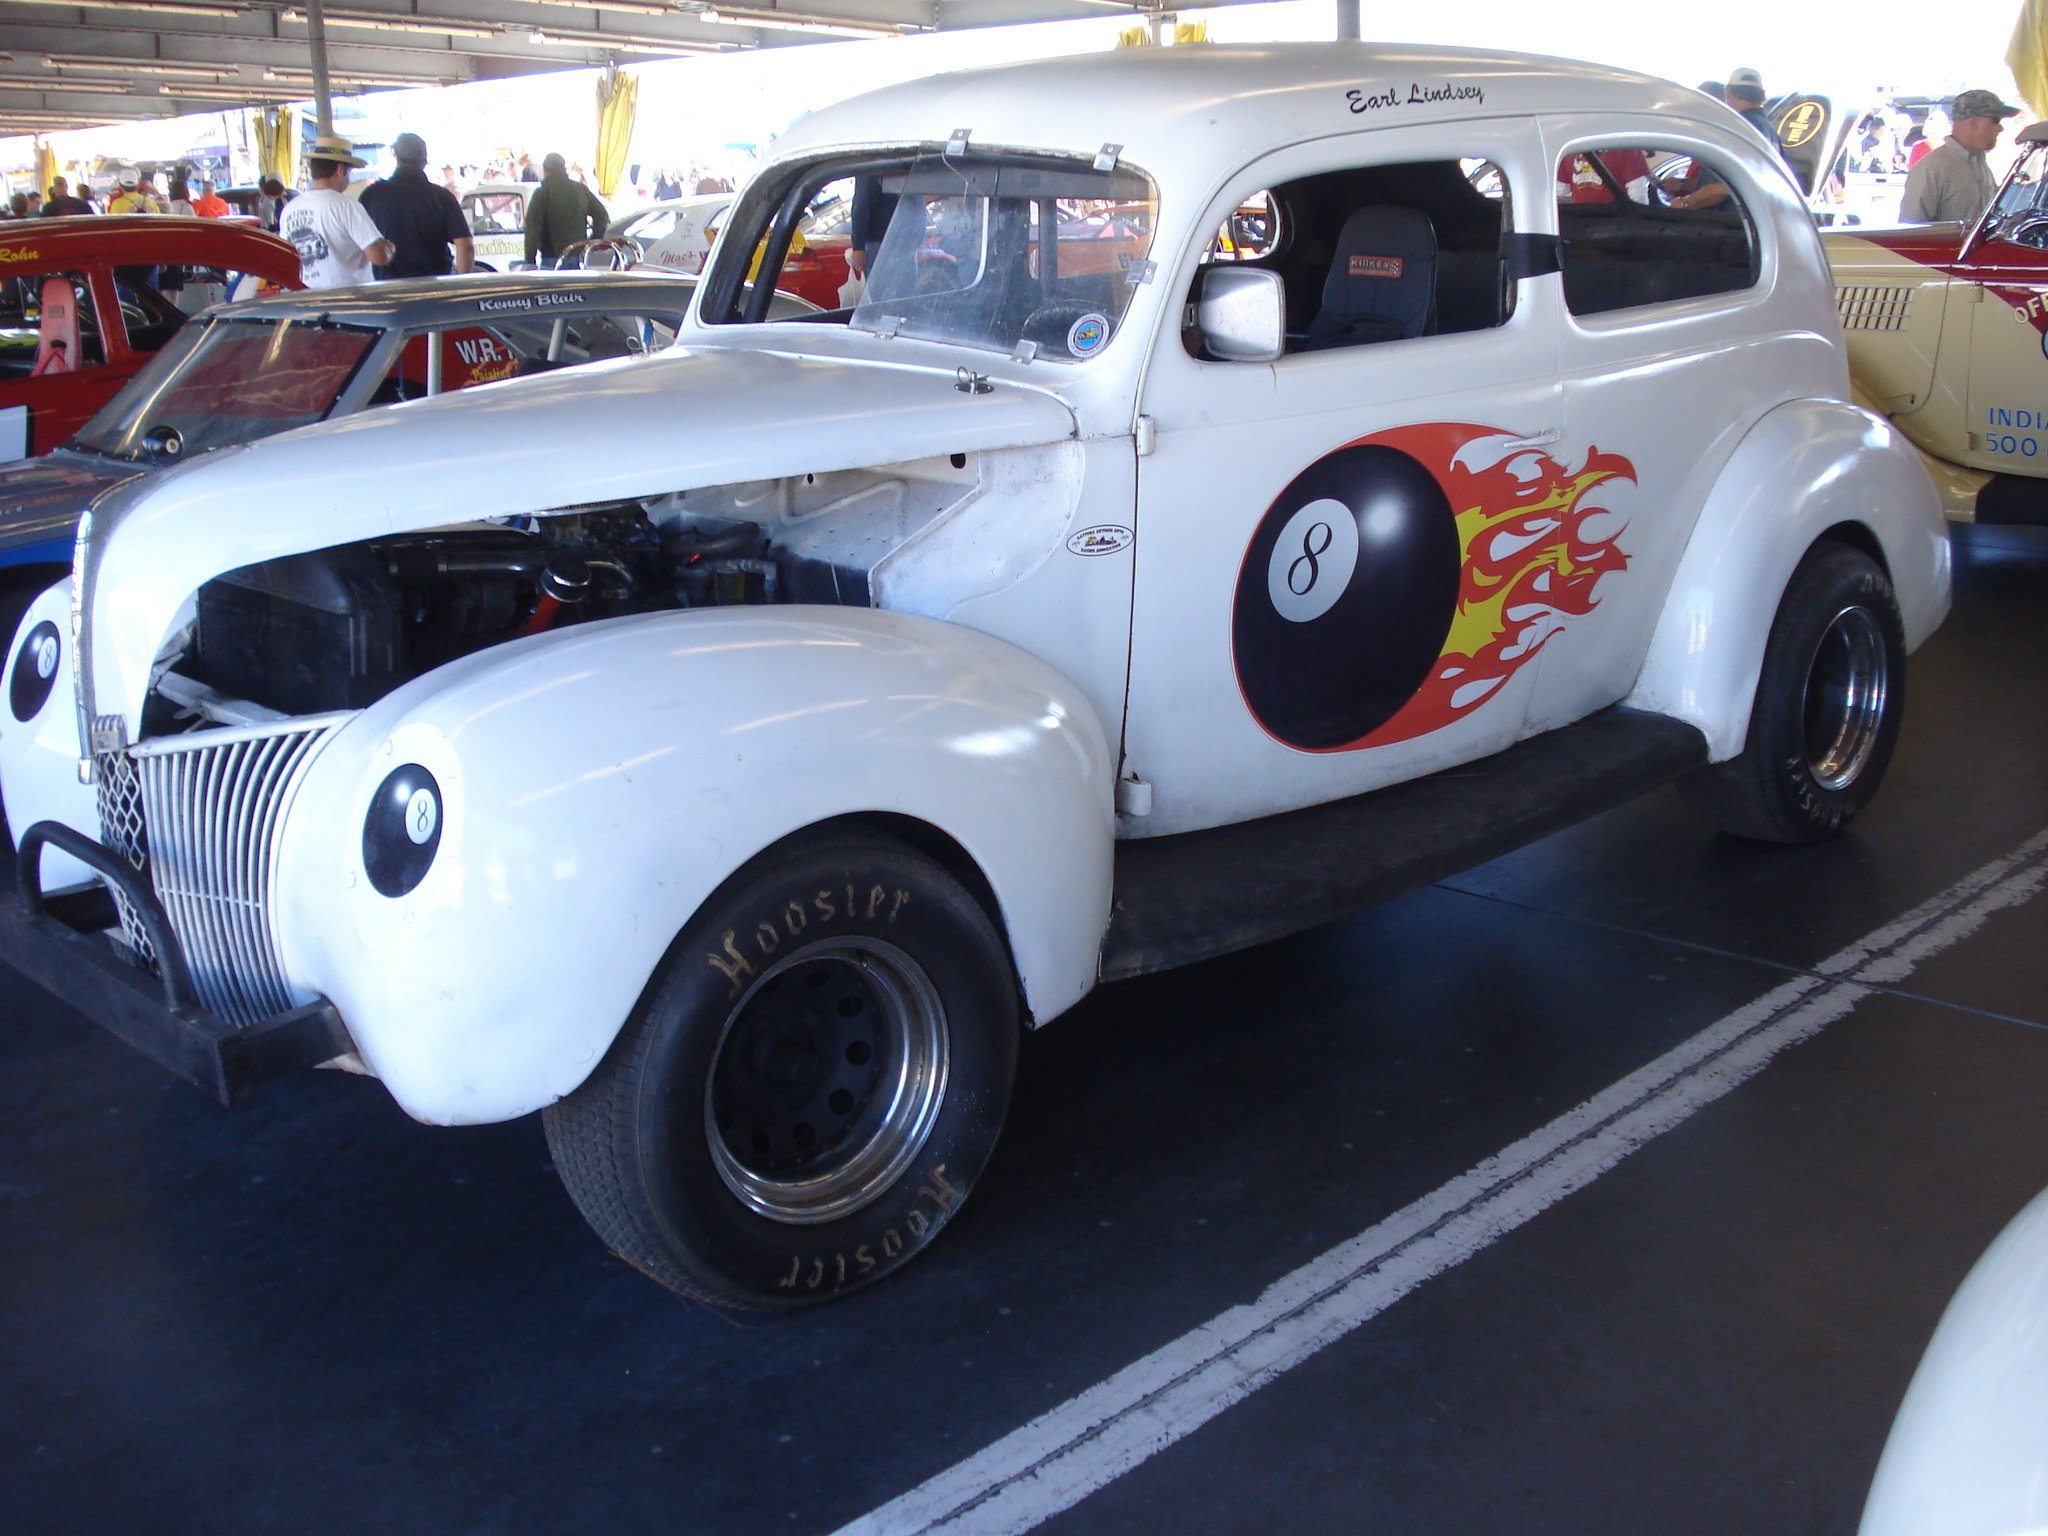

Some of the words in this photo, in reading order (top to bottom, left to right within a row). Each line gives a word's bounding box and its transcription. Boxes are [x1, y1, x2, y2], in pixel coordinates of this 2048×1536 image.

[1346, 87, 1401, 114] Earl
[1407, 82, 1484, 104] Lindsey
[1351, 259, 1390, 268] KIRKEY
[479, 299, 532, 311] Kenny
[534, 293, 584, 306] Blair
[455, 338, 502, 365] W.R.
[1989, 407, 2048, 430] INDI
[1986, 433, 2038, 457] 500
[1287, 522, 1333, 596] 8
[45, 644, 52, 669] 8
[417, 799, 428, 833] 8
